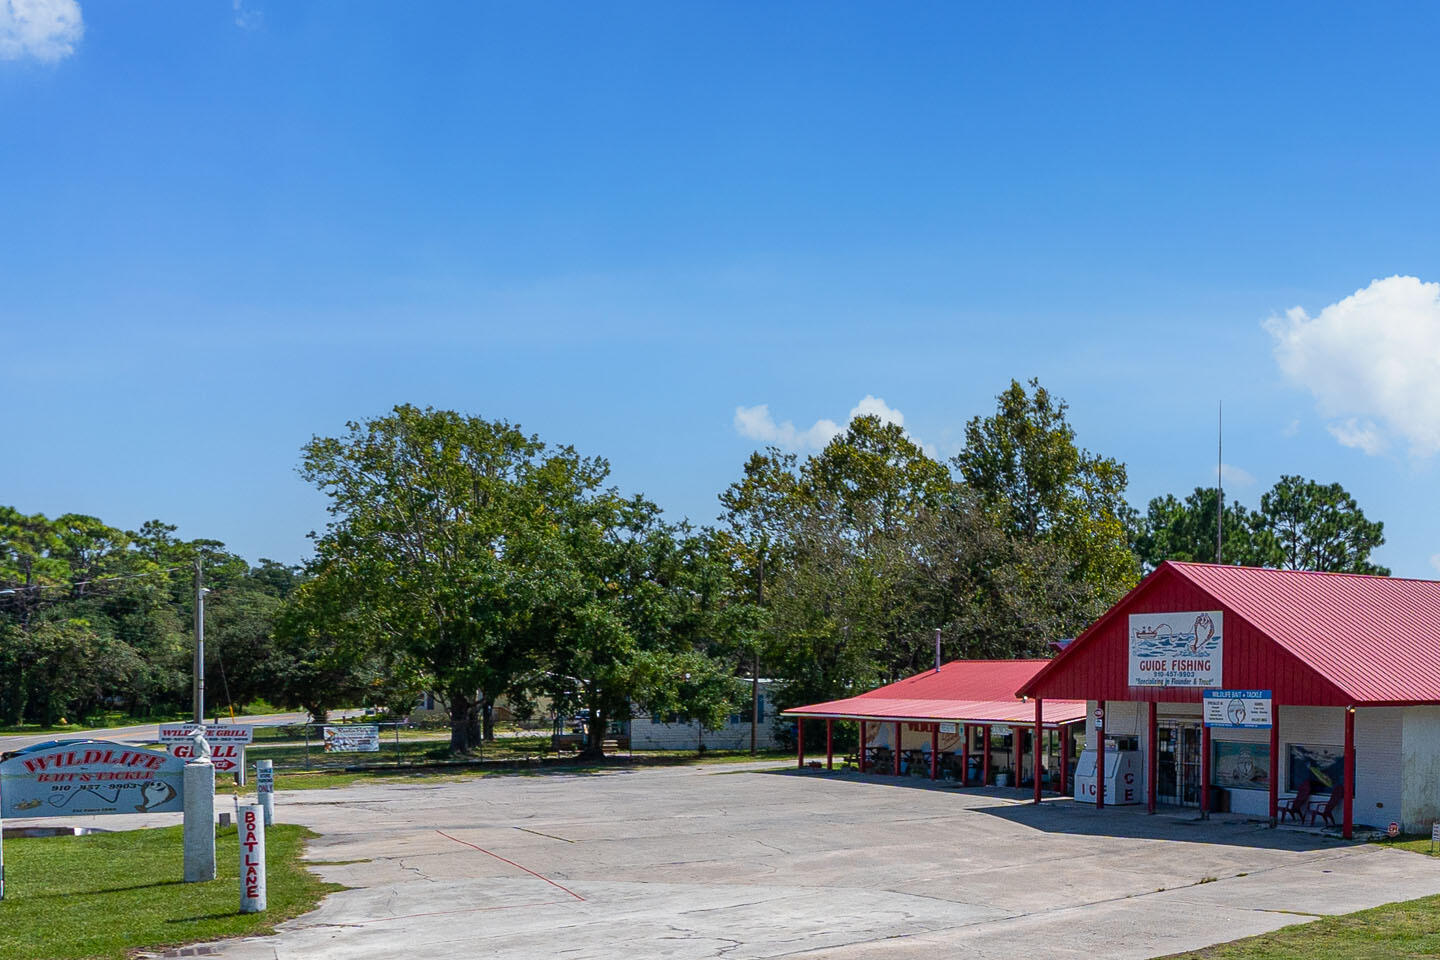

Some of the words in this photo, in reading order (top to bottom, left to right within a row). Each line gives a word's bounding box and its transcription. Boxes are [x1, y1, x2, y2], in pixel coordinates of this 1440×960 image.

[1140, 660, 1167, 671] GUIDE
[1172, 660, 1211, 671] FISHING
[23, 749, 166, 773] WILDLIFE
[173, 745, 238, 758] GLL
[36, 772, 76, 782] BAIT
[94, 770, 155, 781] TACKLE
[1124, 759, 1135, 801] ICE
[243, 811, 259, 853] BOAT
[245, 854, 259, 899] LANE
